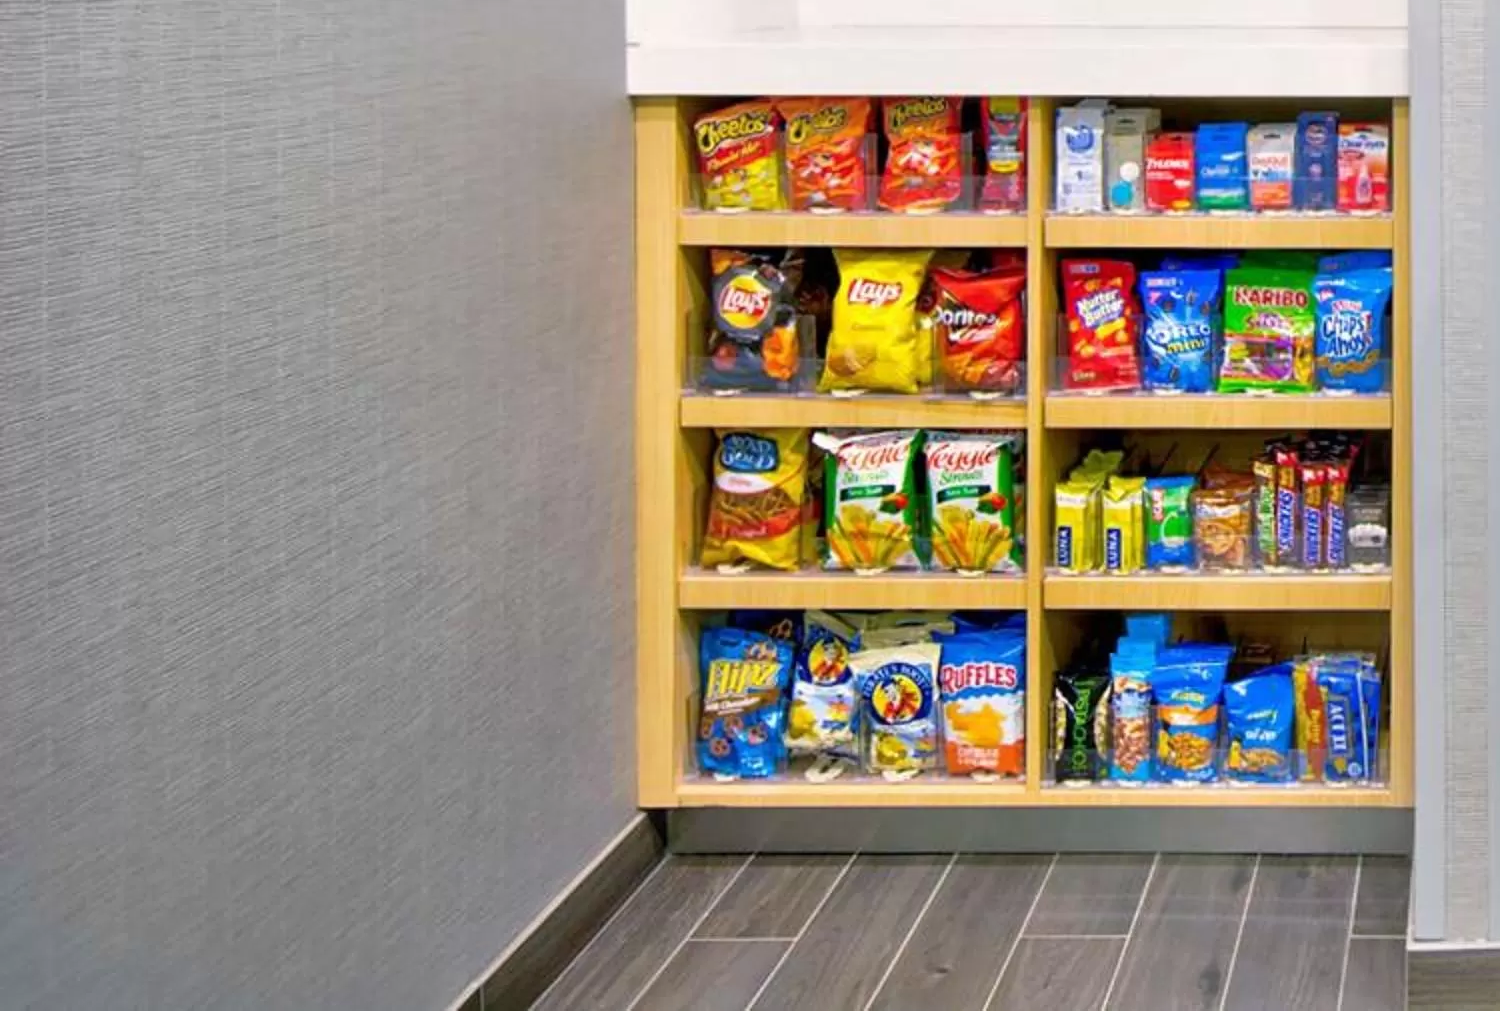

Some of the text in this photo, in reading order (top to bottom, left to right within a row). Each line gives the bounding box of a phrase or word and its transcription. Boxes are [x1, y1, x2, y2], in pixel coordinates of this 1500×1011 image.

[697, 109, 769, 154] Cheetos
[1234, 286, 1309, 308] HARIBO
[1146, 323, 1211, 345] OREO
[941, 663, 1016, 694] RUFFLES
